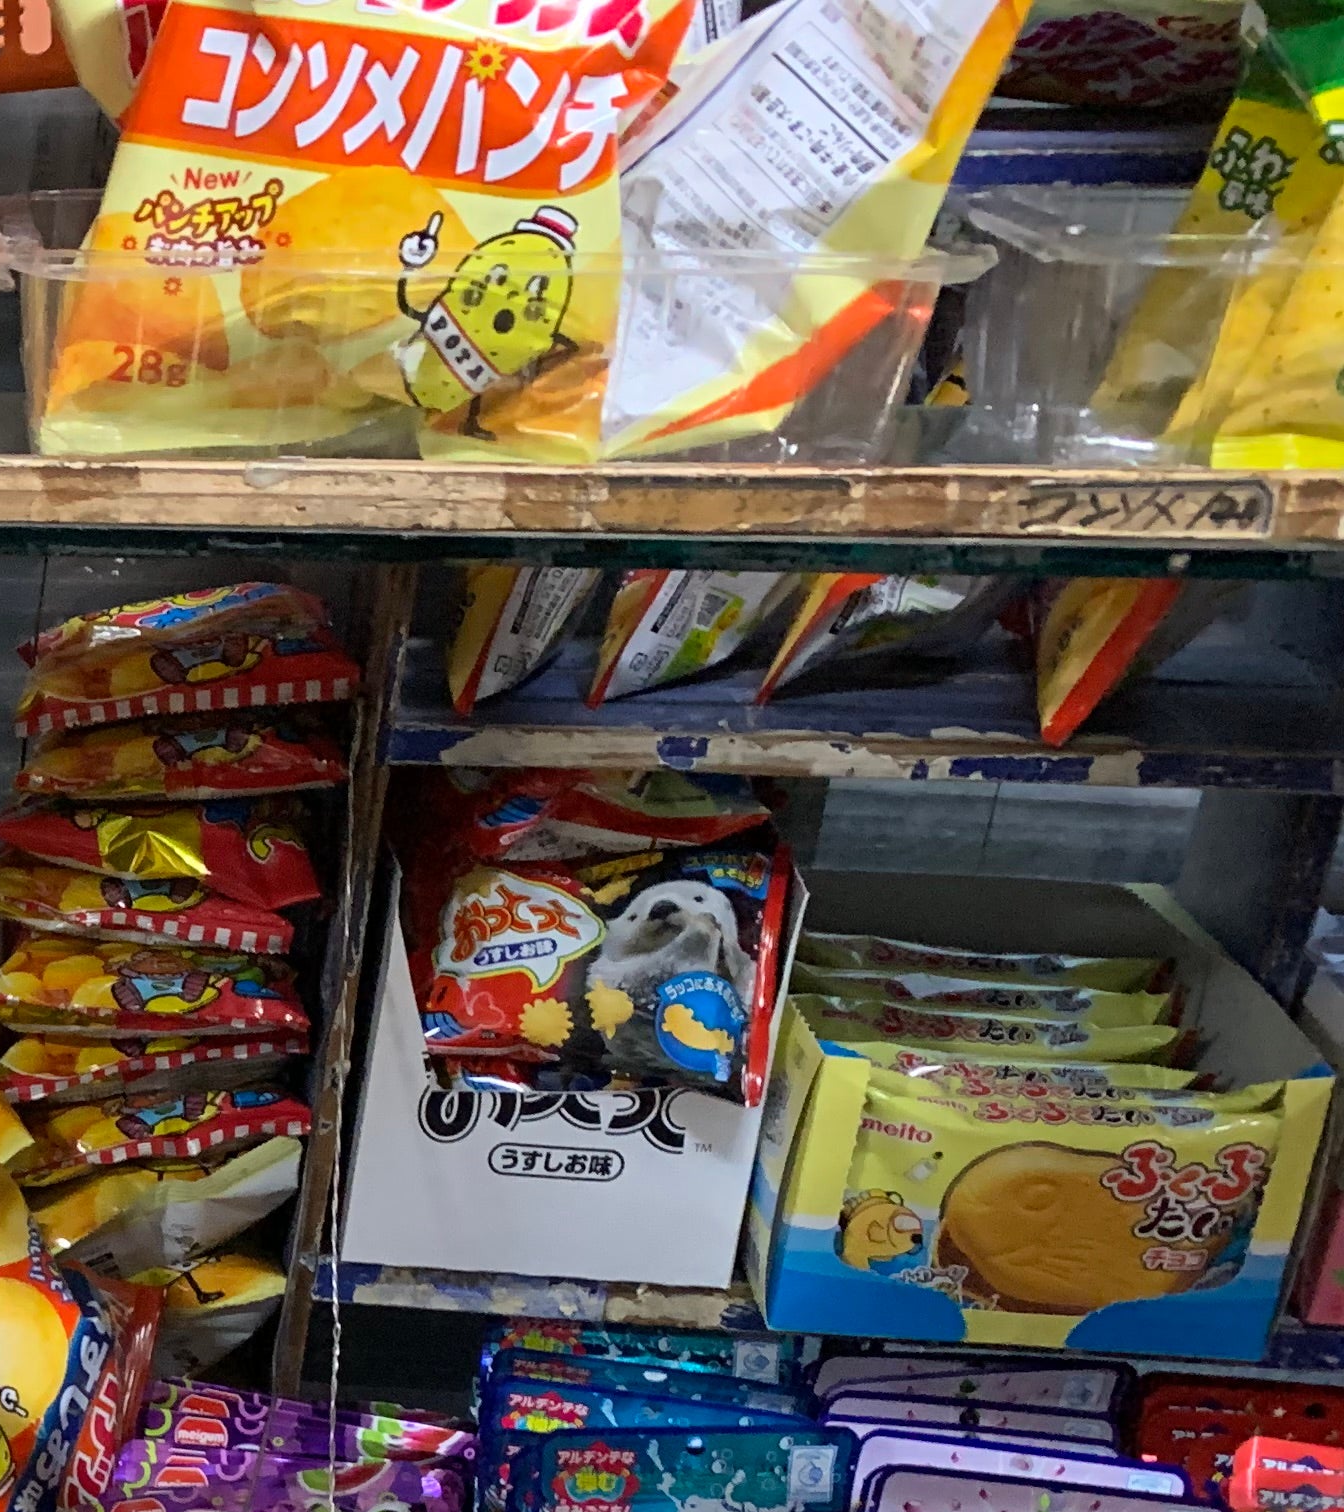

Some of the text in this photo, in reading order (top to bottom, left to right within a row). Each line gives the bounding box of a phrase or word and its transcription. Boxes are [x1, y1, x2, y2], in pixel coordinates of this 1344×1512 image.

[181, 26, 628, 191] コンソメパンチ
[183, 167, 240, 191] New
[133, 178, 284, 239] パンチアップ
[108, 345, 188, 388] 28g
[451, 884, 582, 963] おっとっと
[473, 938, 558, 966] うすしお味
[499, 1147, 613, 1178] うすしお味
[1141, 1247, 1209, 1273] チョコ
